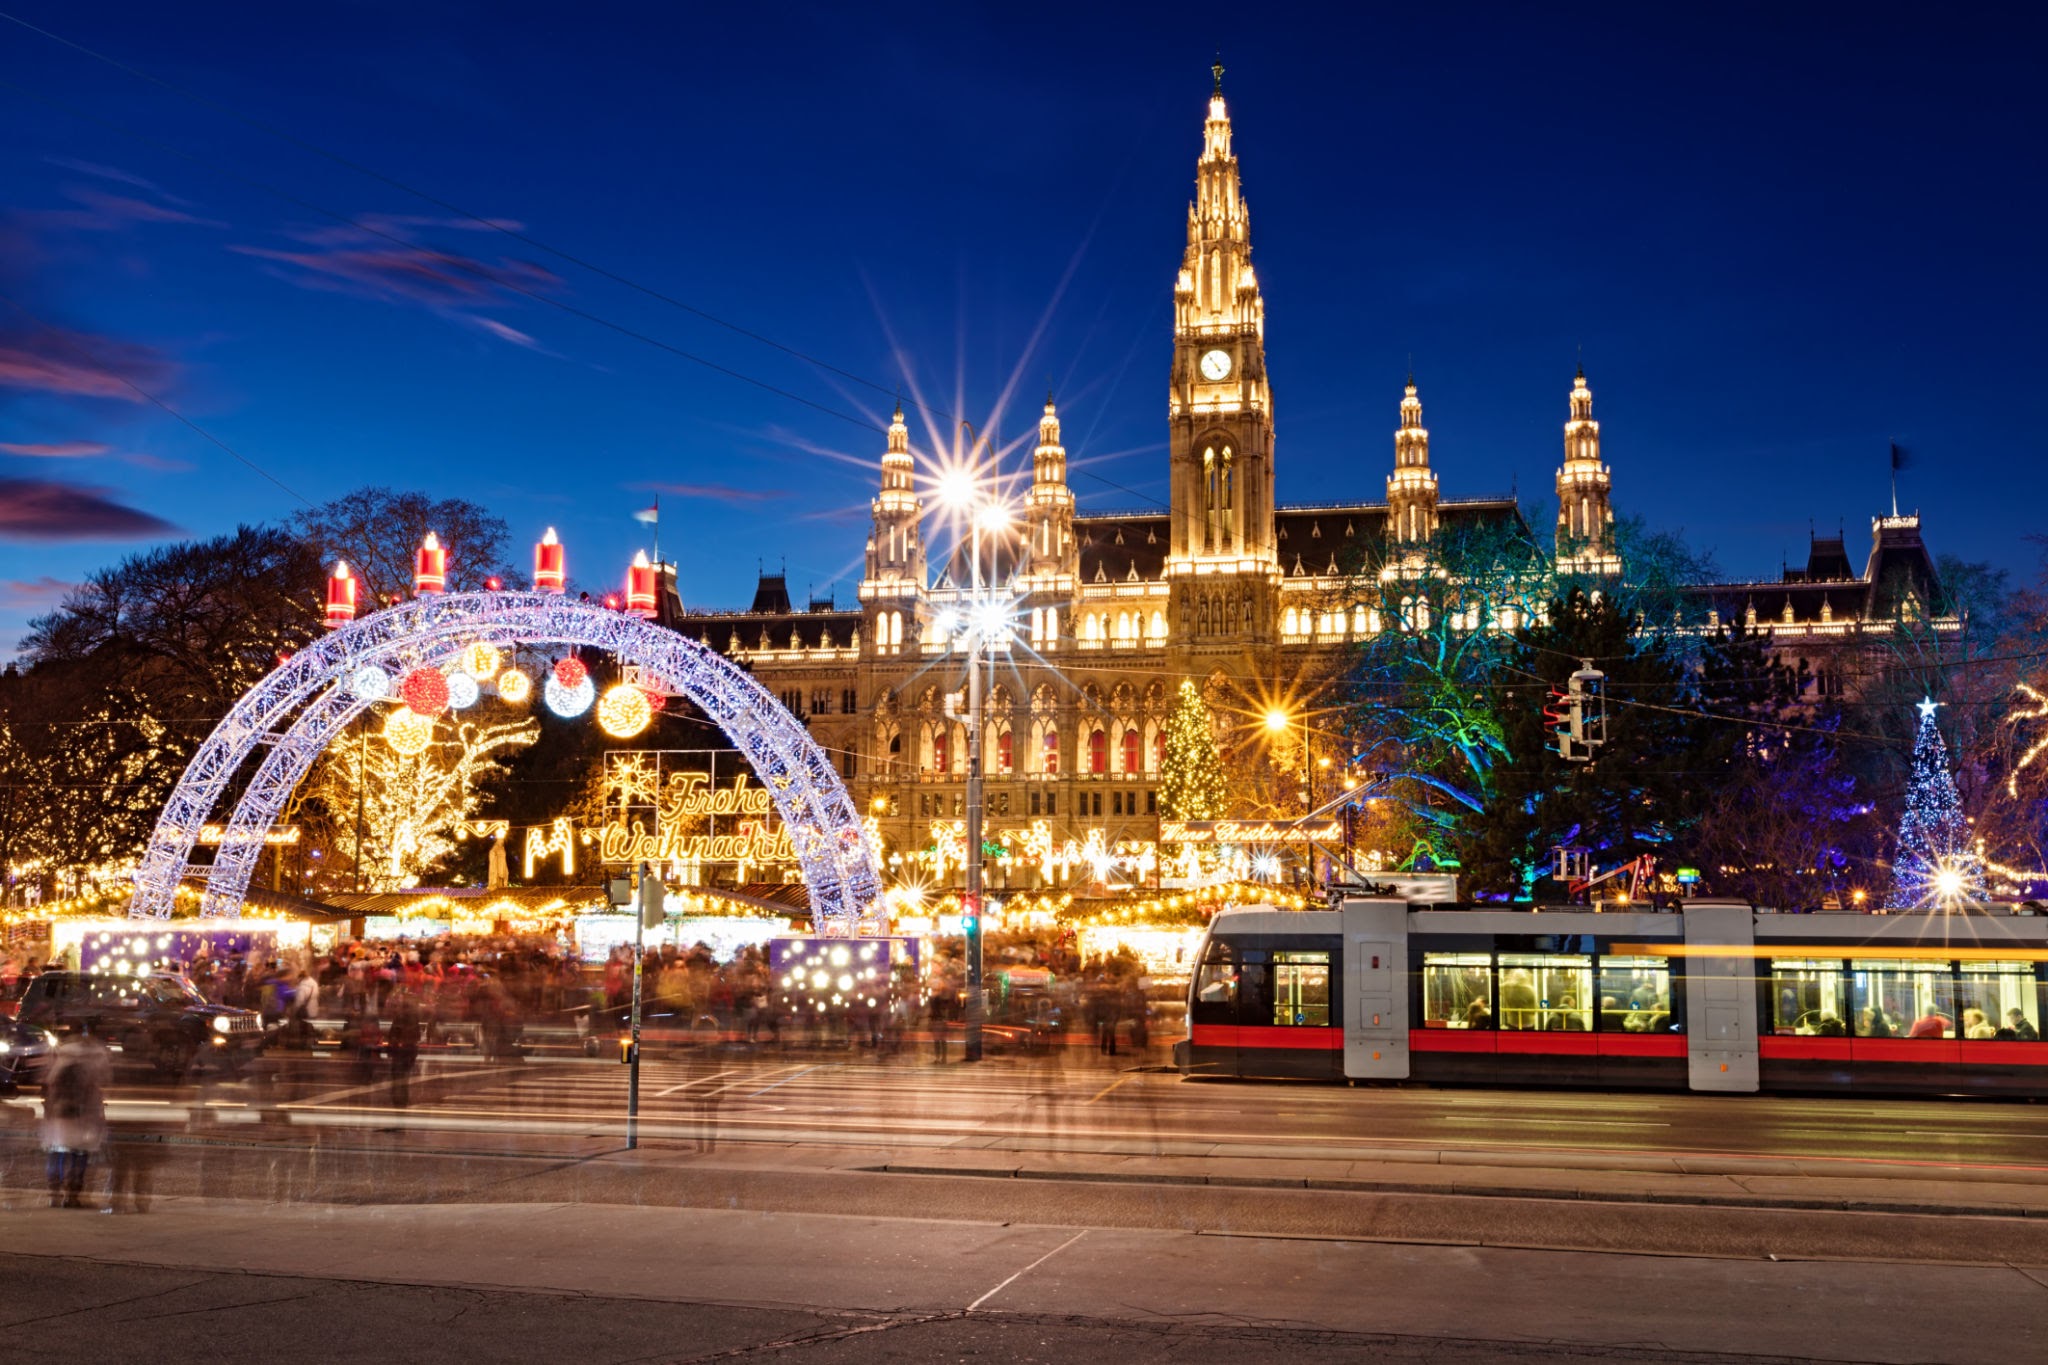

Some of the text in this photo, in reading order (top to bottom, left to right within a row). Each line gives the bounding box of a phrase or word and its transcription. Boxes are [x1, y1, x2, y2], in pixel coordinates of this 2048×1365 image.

[658, 772, 770, 822] Frohe
[602, 820, 818, 861] Weihnachte
[1160, 823, 1213, 841] Wiener
